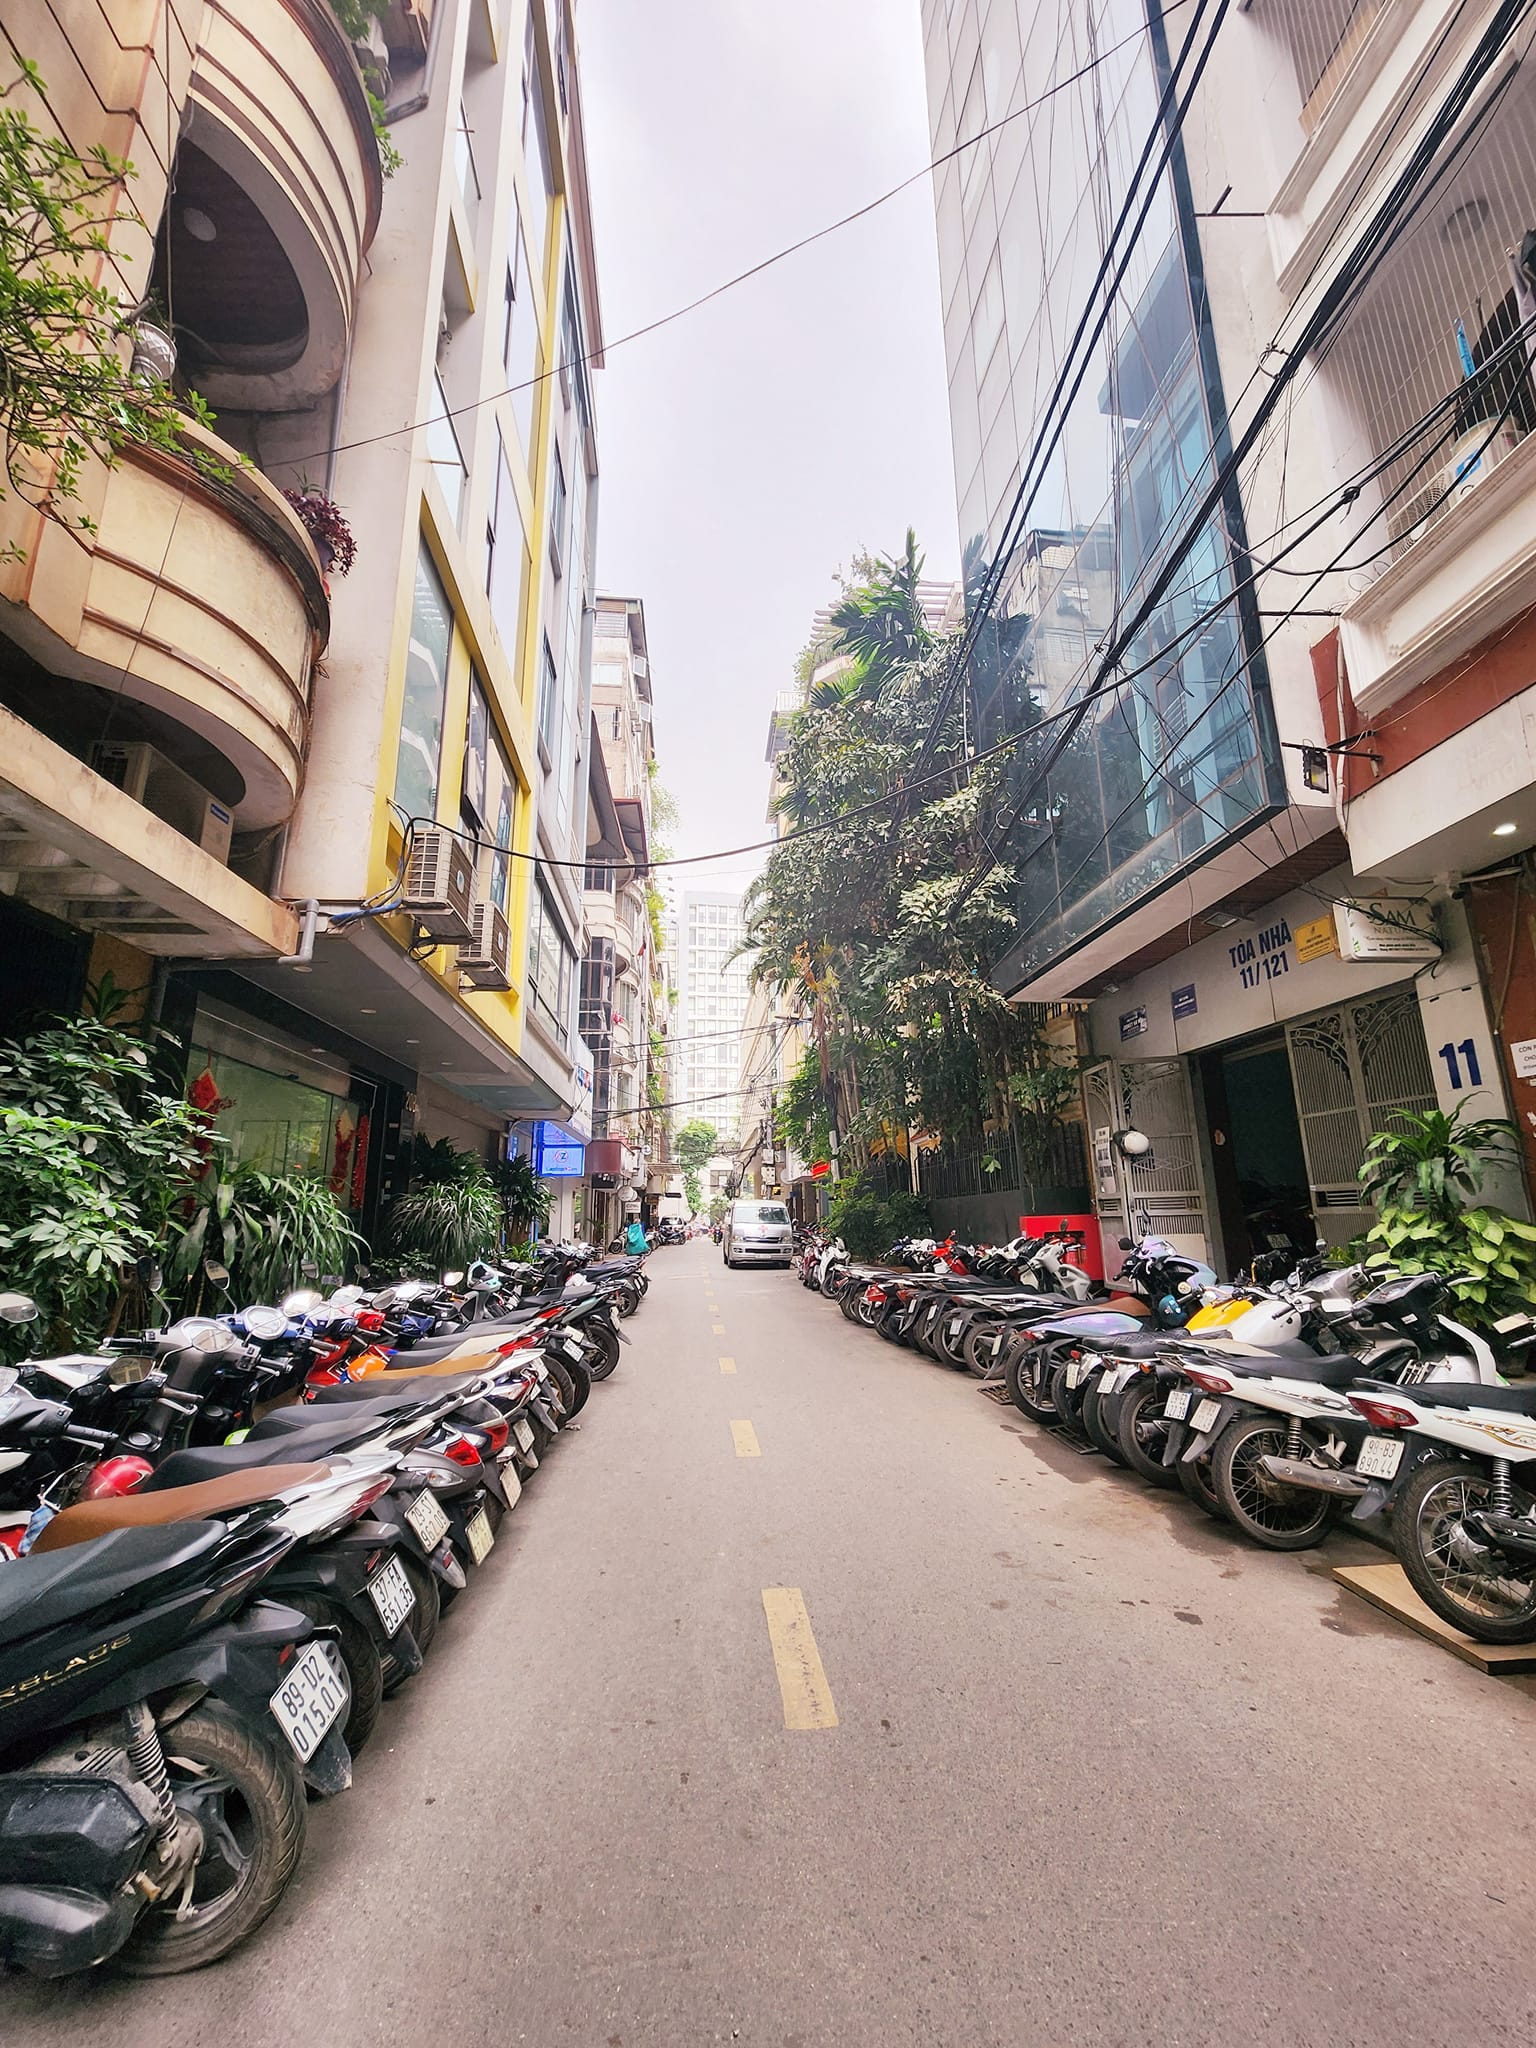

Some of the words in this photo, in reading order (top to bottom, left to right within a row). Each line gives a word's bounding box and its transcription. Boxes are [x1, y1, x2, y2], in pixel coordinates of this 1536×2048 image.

[1229, 938, 1256, 968] TÒA
[1258, 918, 1292, 955] NHÀ
[1240, 950, 1289, 989] 11/121
[1439, 1038, 1483, 1090] 11
[281, 1655, 325, 1718] 89-D2
[292, 1674, 343, 1753] 015.01
